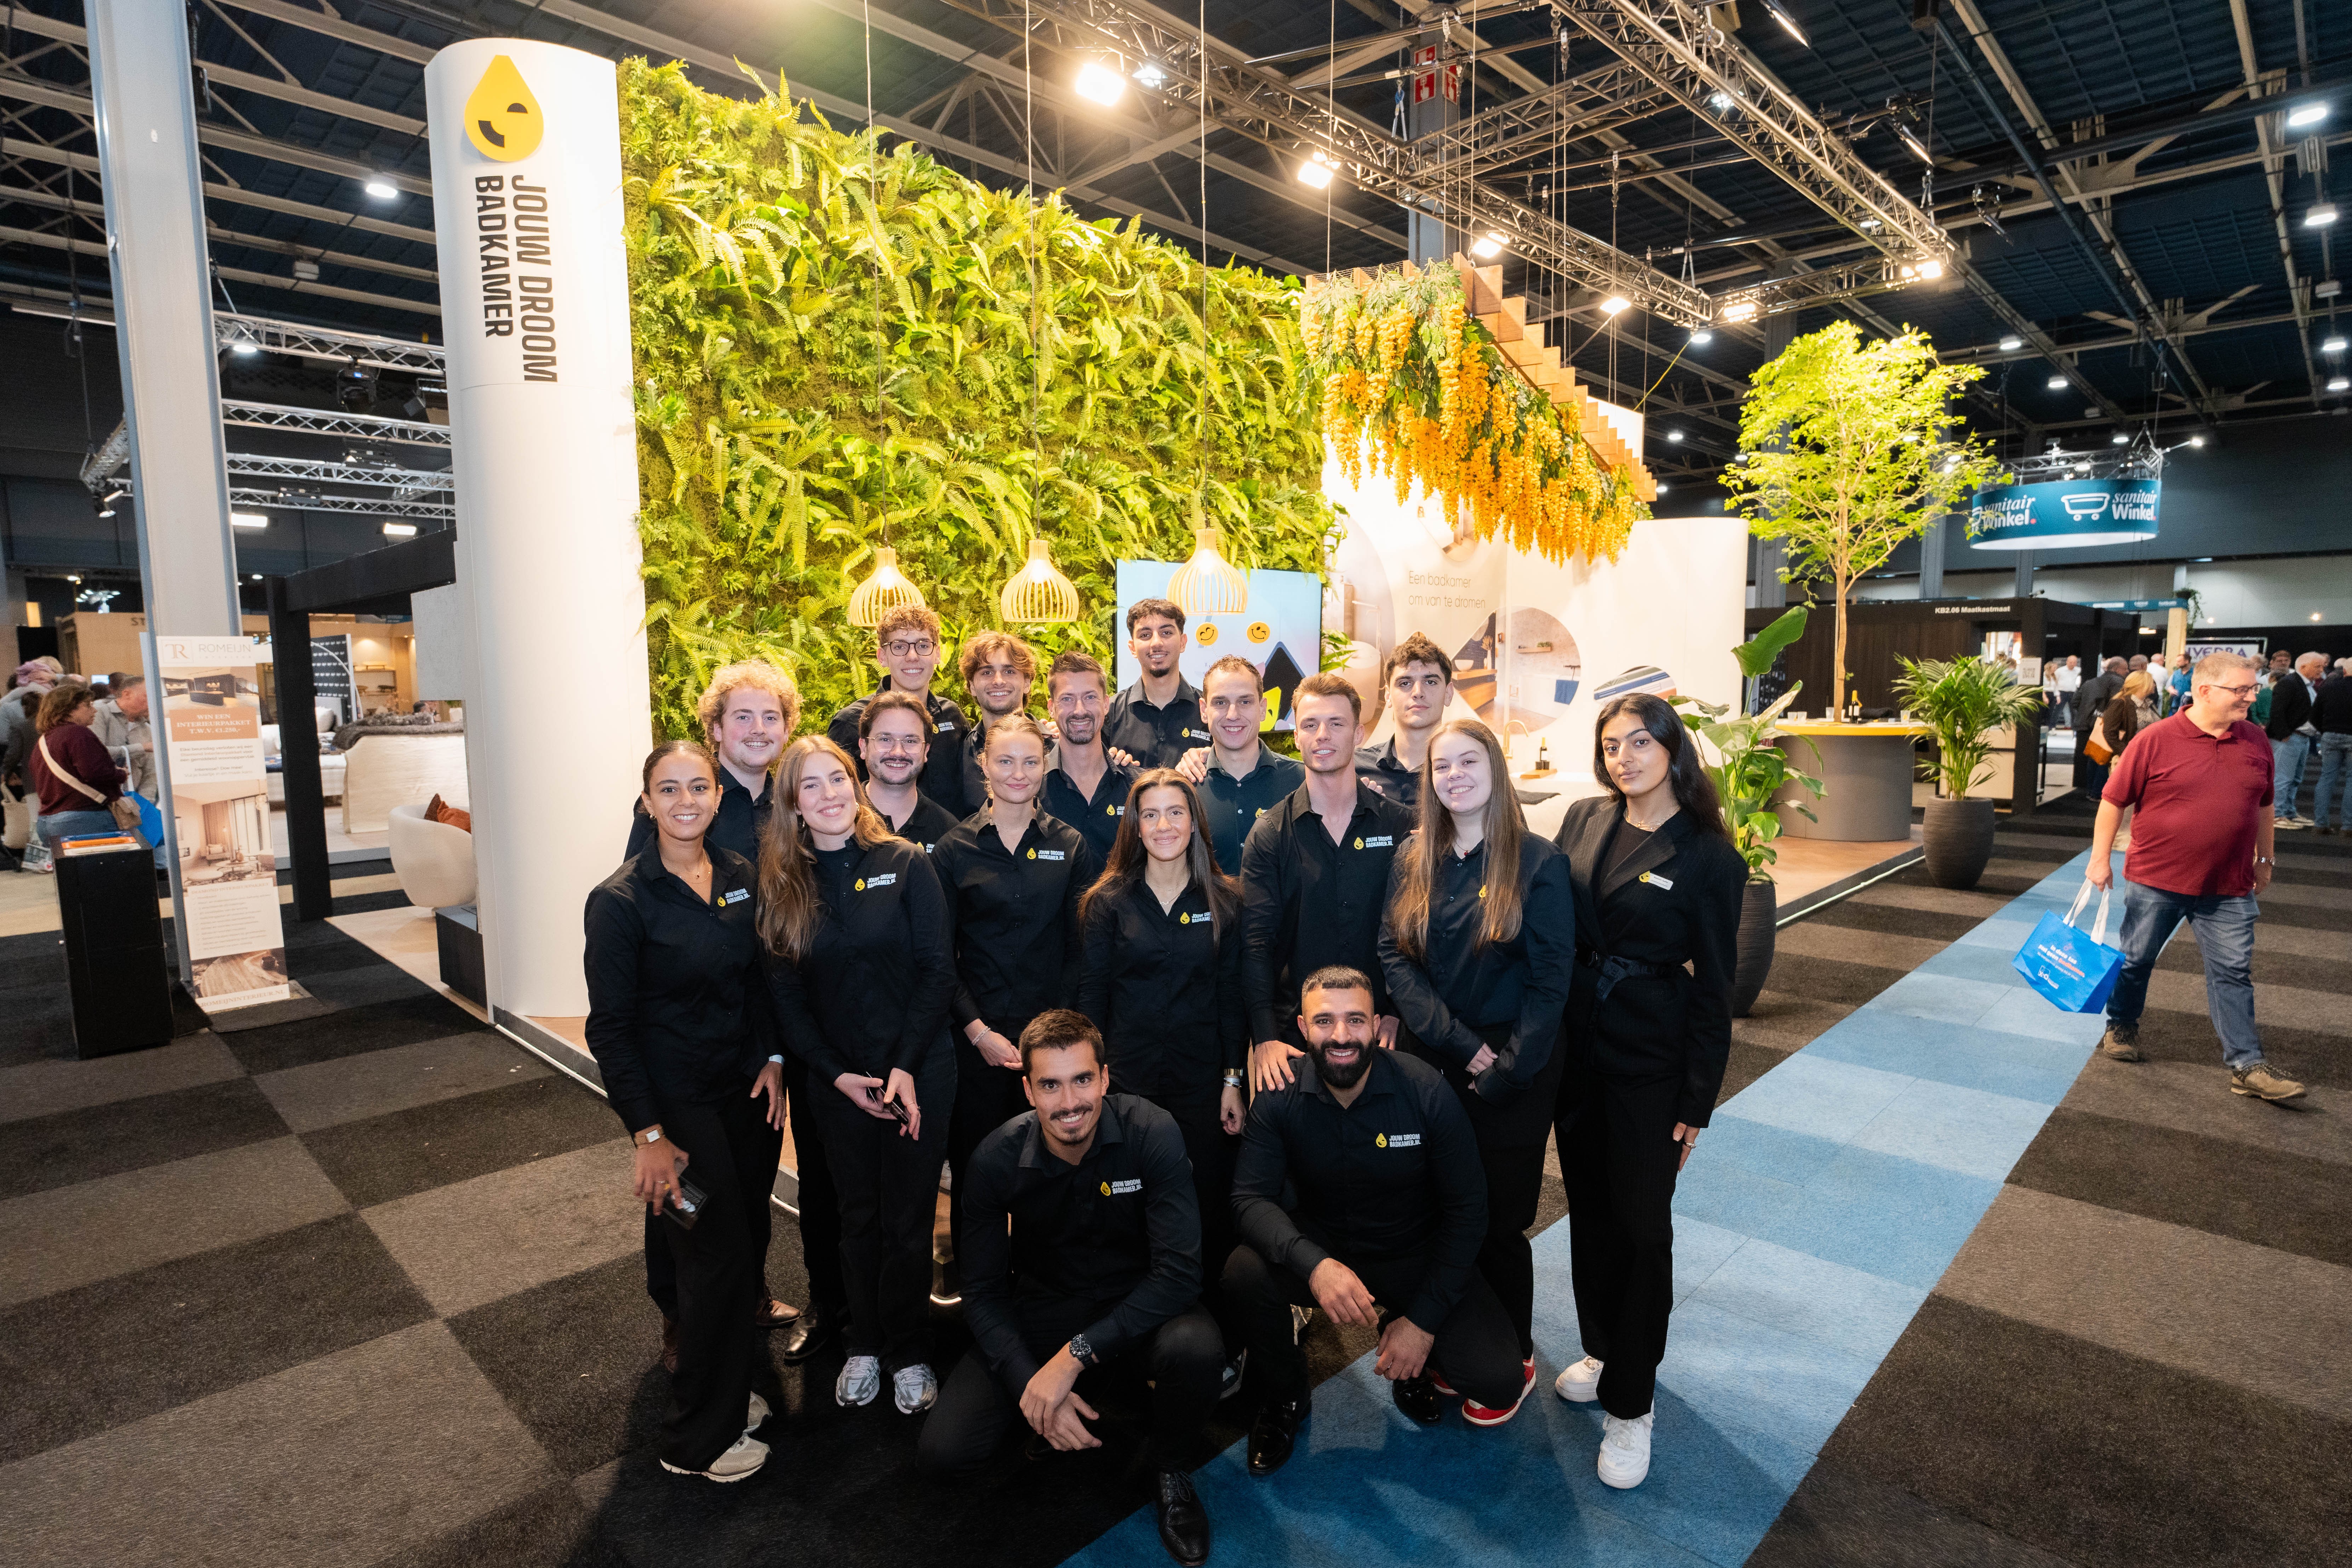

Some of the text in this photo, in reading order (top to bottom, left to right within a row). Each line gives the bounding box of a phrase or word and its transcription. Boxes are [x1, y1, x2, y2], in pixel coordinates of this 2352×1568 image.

[475, 176, 514, 338] BADKAMER
[511, 175, 558, 382] JOUW DROOM
[2112, 489, 2157, 504] sanitair
[2112, 503, 2156, 521] Winkel.
[1409, 571, 1471, 588] Een badkamer
[1409, 595, 1485, 608] om van te dromen
[199, 644, 251, 652] ROMEIJN
[867, 878, 896, 888] BADKAMER.NL
[726, 893, 750, 904] BADKAMER.NL
[1112, 1184, 1143, 1194] BADKAMER.NL
